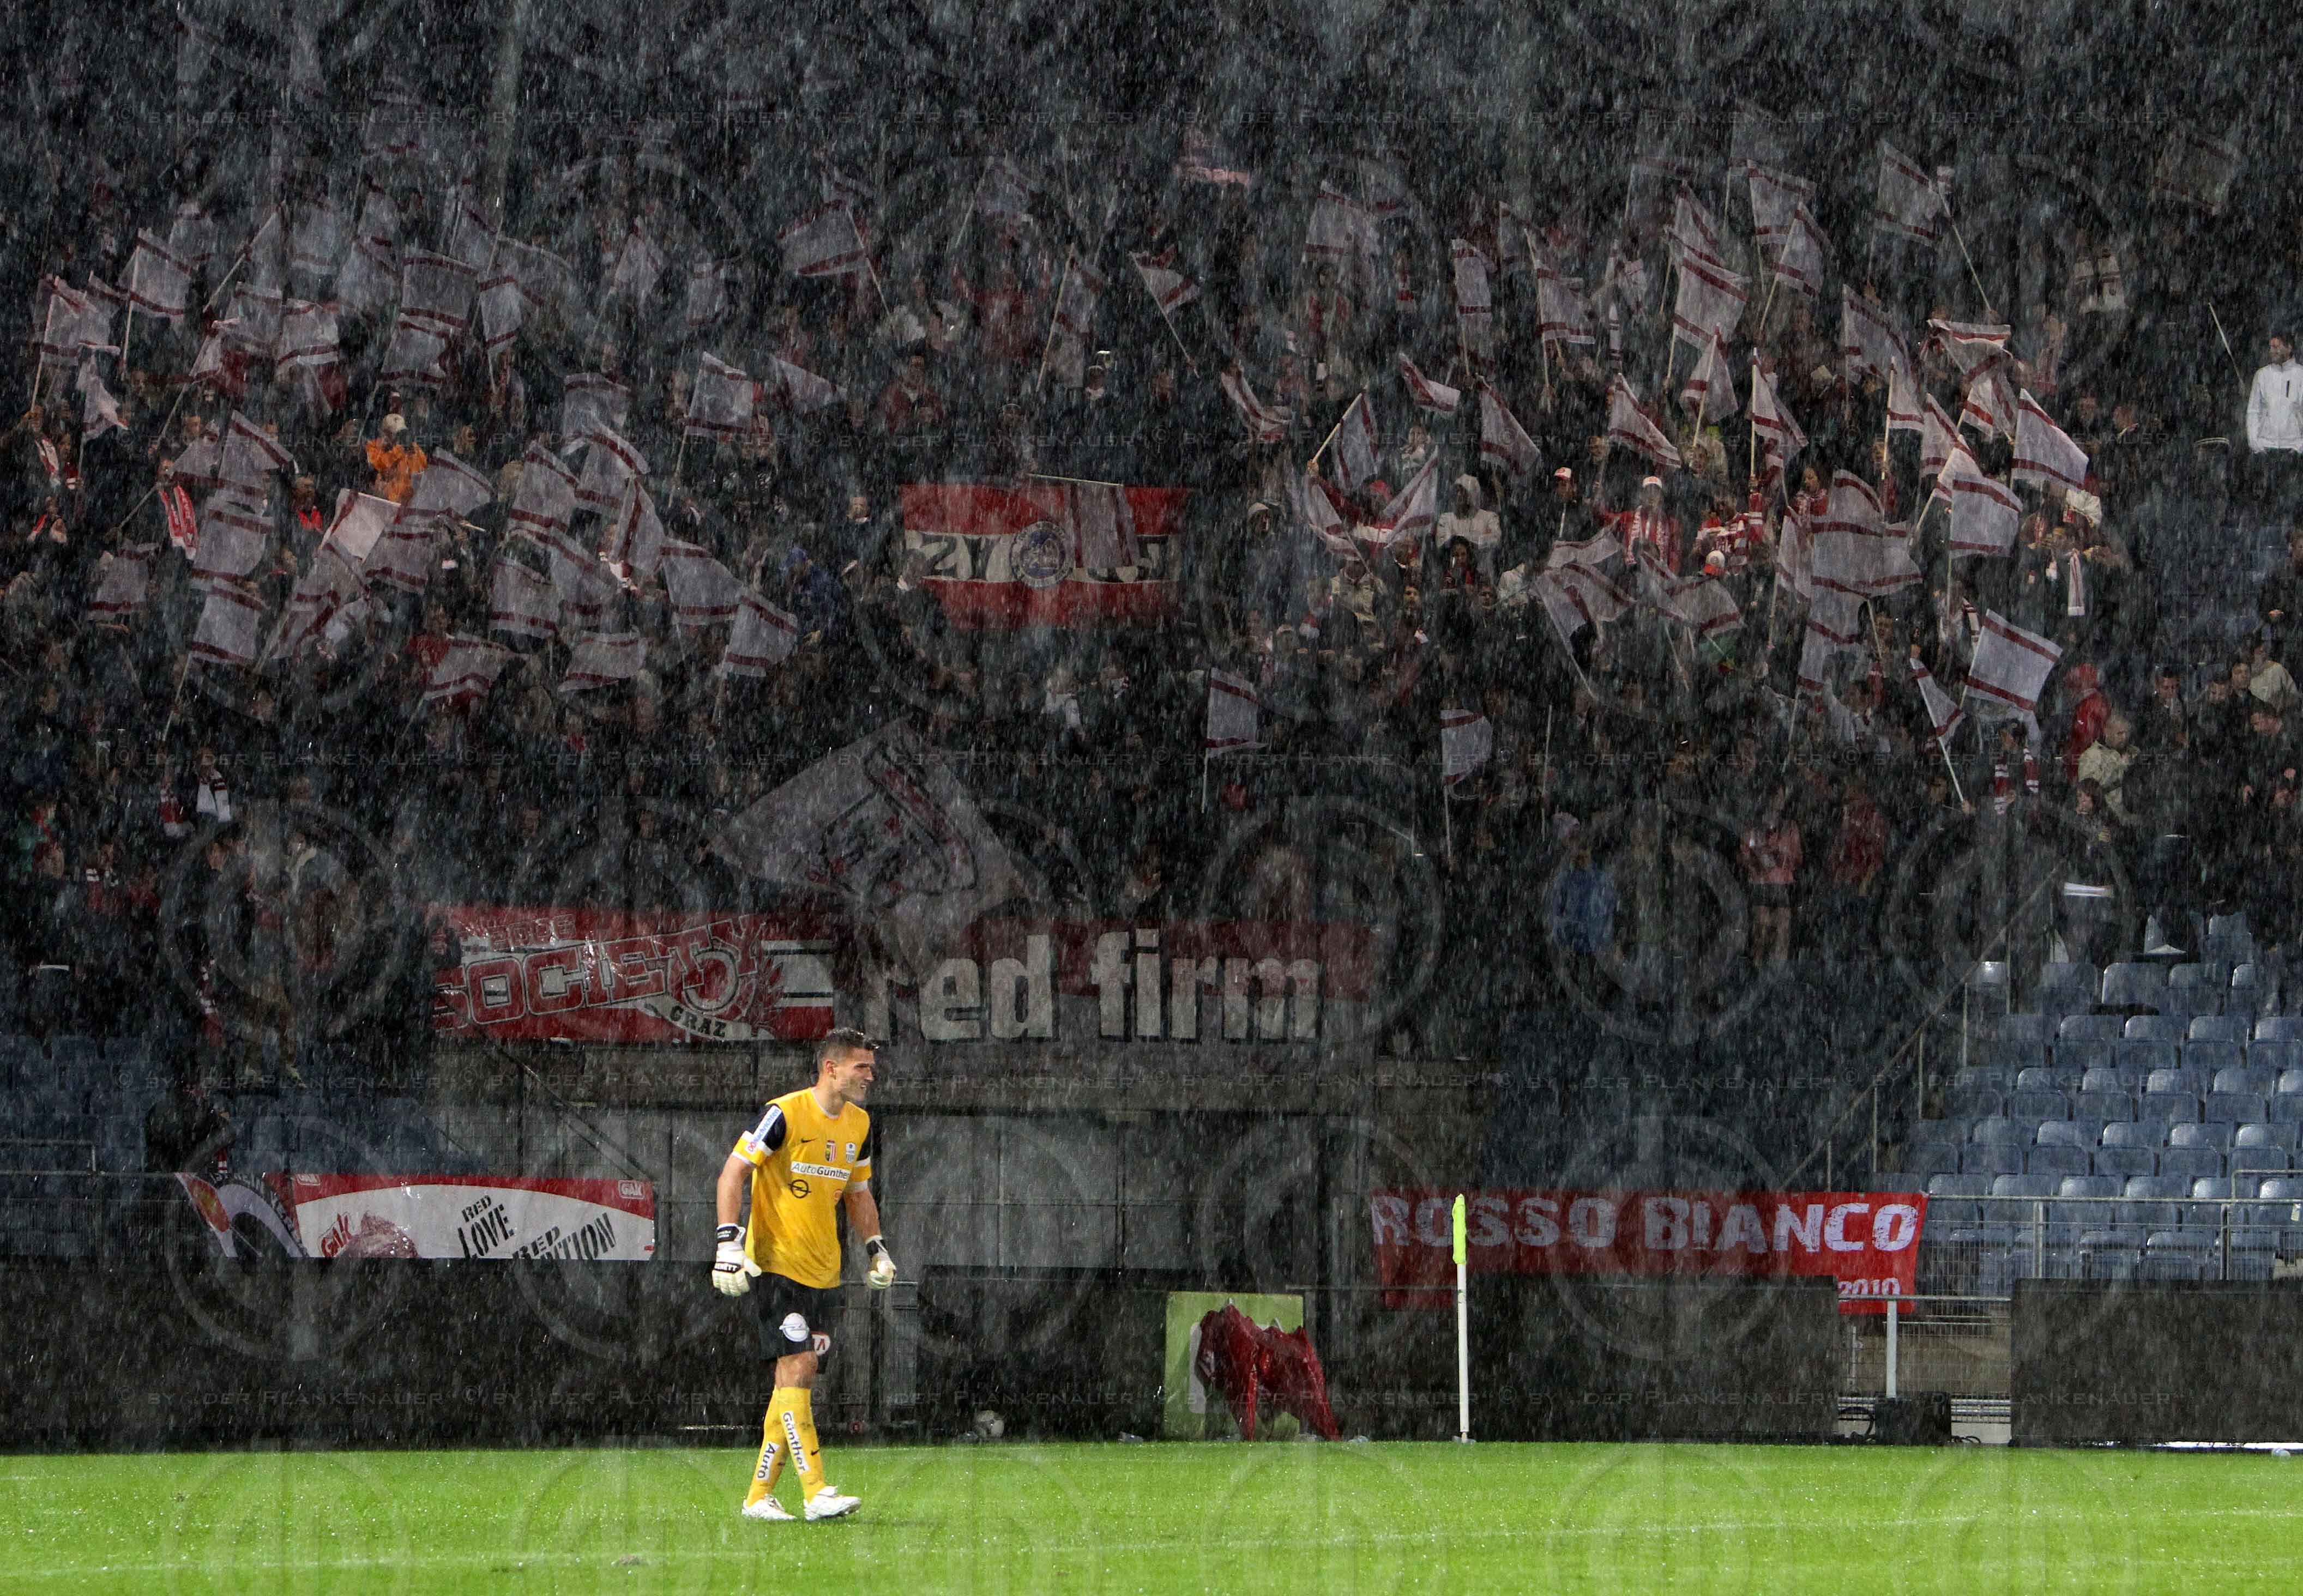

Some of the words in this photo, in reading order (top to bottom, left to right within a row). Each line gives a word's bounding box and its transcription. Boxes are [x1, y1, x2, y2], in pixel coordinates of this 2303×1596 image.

[863, 934, 1053, 1040] red
[1092, 928, 1317, 1037] firm
[671, 1005, 726, 1037] GRAZ
[462, 1195, 492, 1223] RED
[1371, 1195, 1618, 1247] ROSSO
[1643, 1197, 1919, 1253] BIANCO
[458, 1204, 516, 1259] LOVE
[1837, 1277, 1901, 1297] 2010
[757, 1442, 776, 1479] Auto
